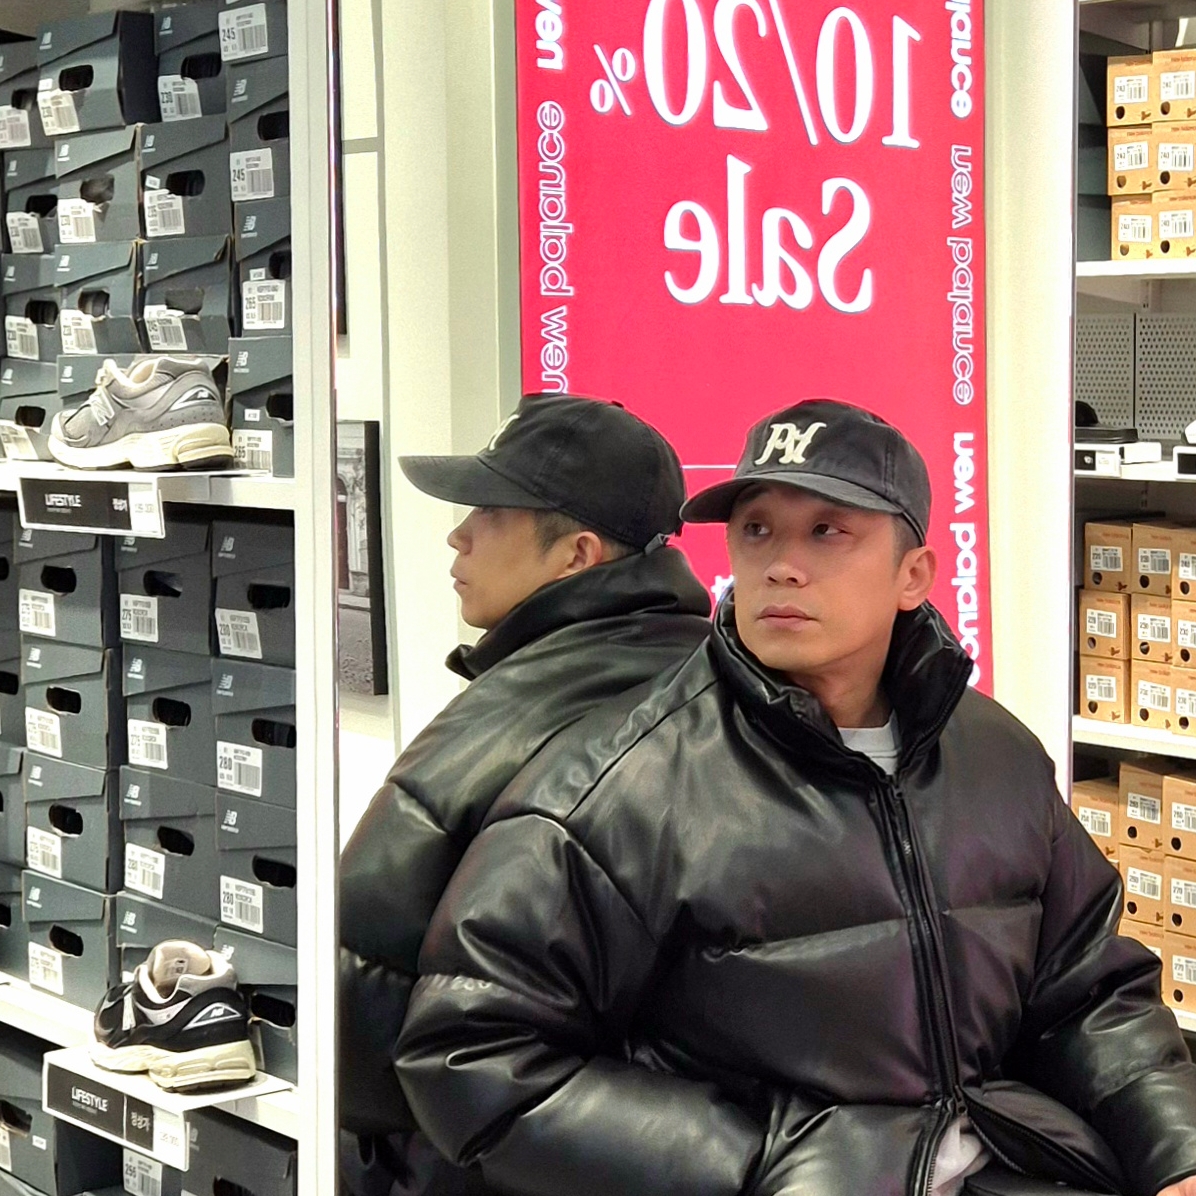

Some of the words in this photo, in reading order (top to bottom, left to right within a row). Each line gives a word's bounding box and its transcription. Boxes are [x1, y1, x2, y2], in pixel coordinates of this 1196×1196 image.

[221, 28, 236, 41] 245
[233, 169, 246, 182] 245
[45, 493, 82, 507] LIFESTYLE
[71, 1086, 108, 1112] LIFESTYLE
